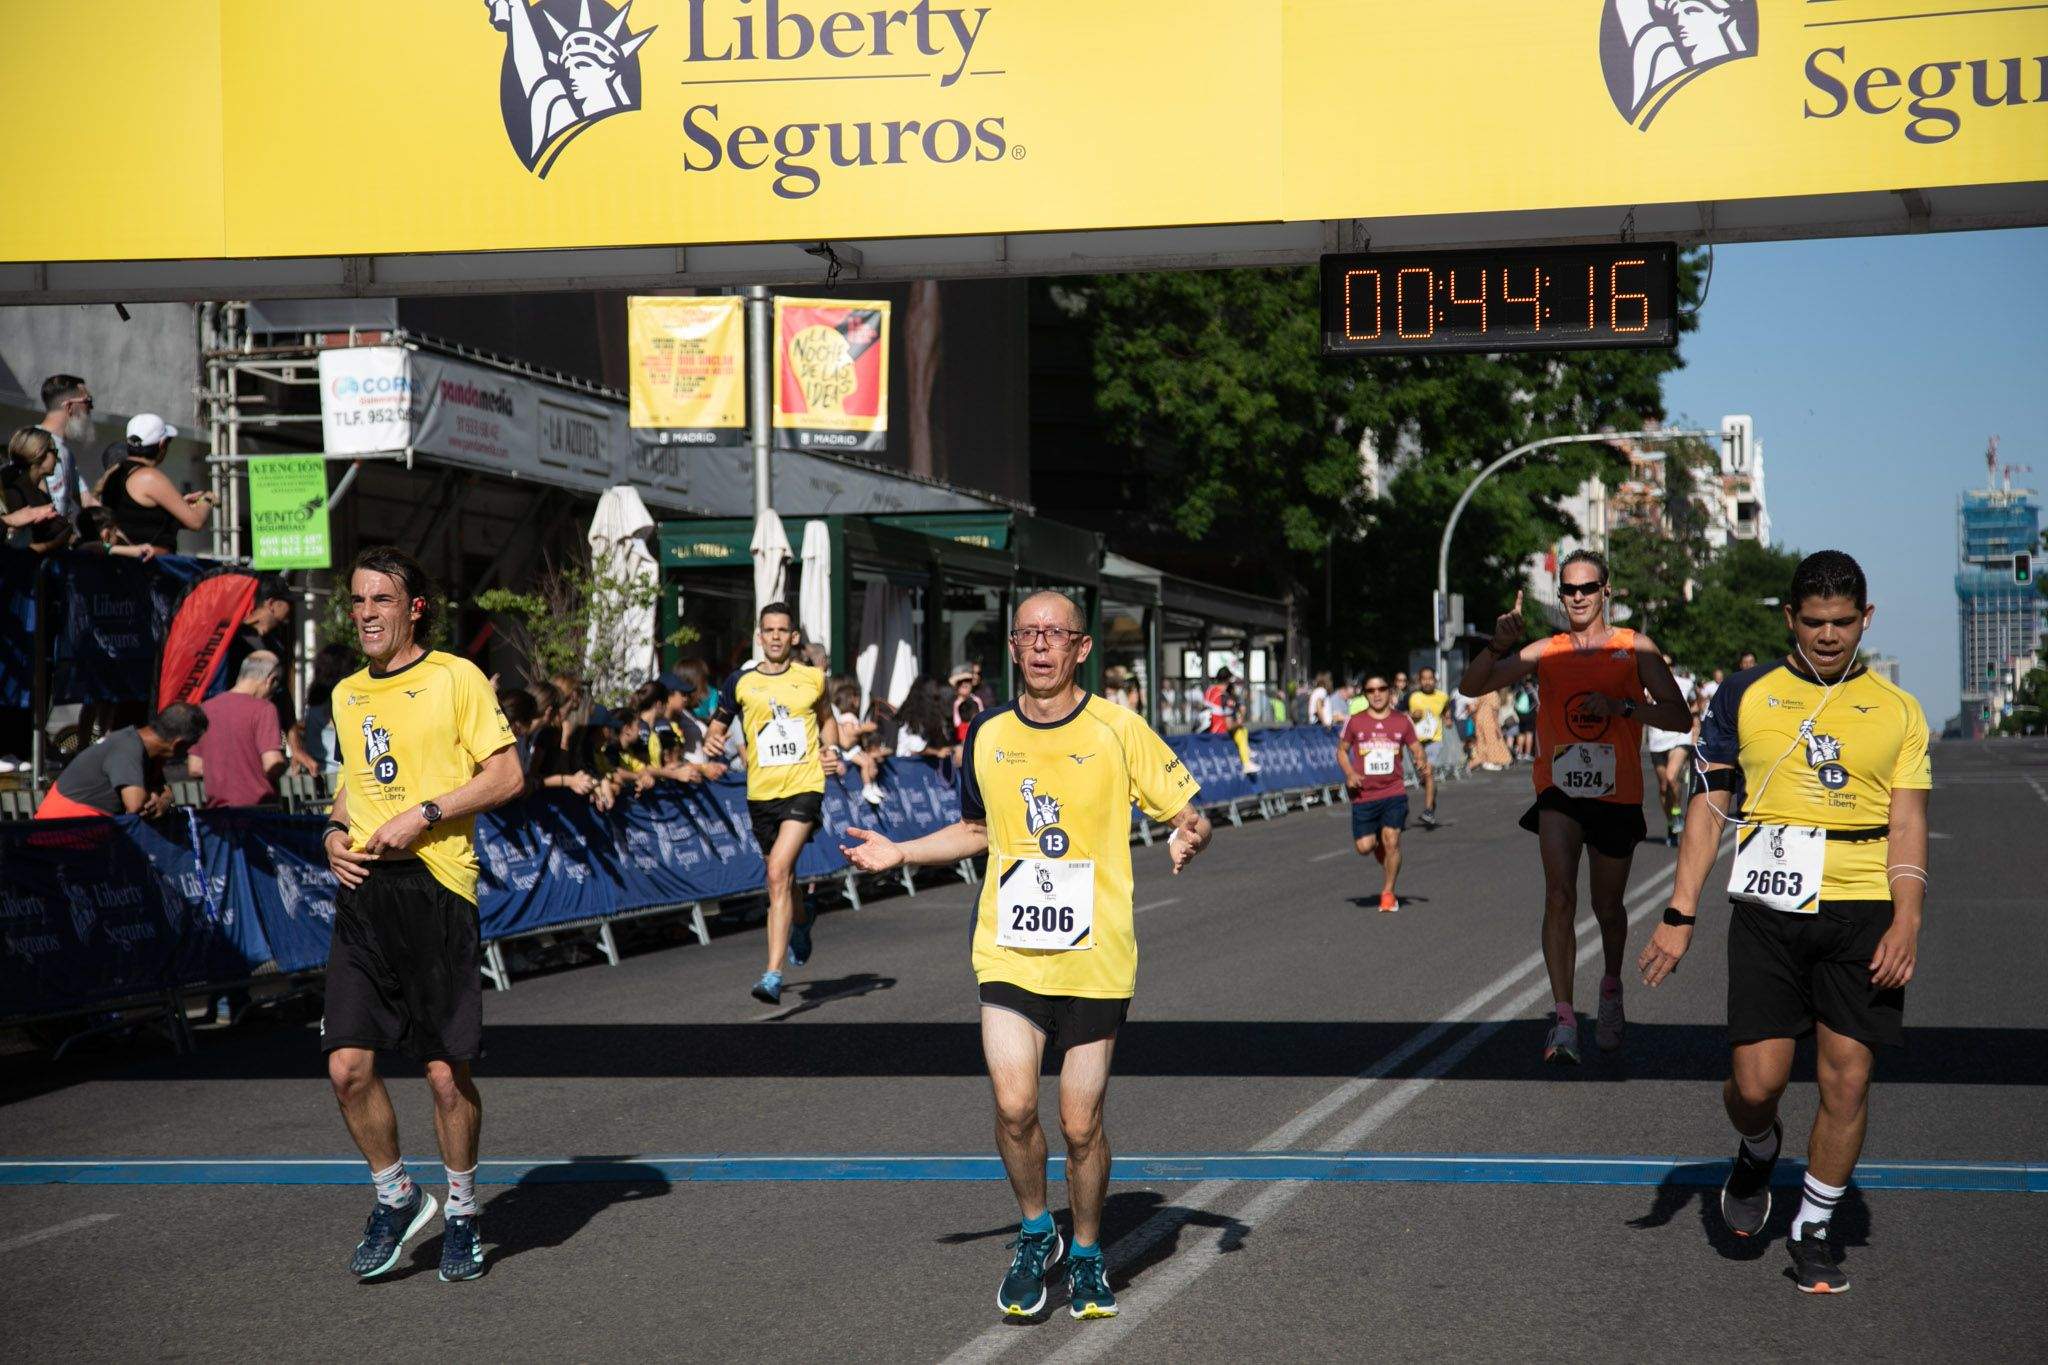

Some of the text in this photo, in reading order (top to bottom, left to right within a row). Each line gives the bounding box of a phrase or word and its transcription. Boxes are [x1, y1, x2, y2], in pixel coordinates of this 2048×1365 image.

[683, 0, 992, 87] Liberty
[683, 104, 1006, 199] Seguros
[1345, 259, 1649, 341] 00:44:16
[672, 432, 717, 444] MADRID
[813, 434, 858, 446] MADRID
[769, 742, 797, 757] 1149
[380, 761, 395, 778] 13
[1824, 769, 1843, 784] 13
[1565, 770, 1603, 788] 1524
[1828, 790, 1857, 801] Carrera
[1828, 799, 1857, 809] Liberty
[1045, 834, 1063, 851] 13
[1744, 869, 1804, 897] 2663
[1011, 904, 1075, 932] 2306
